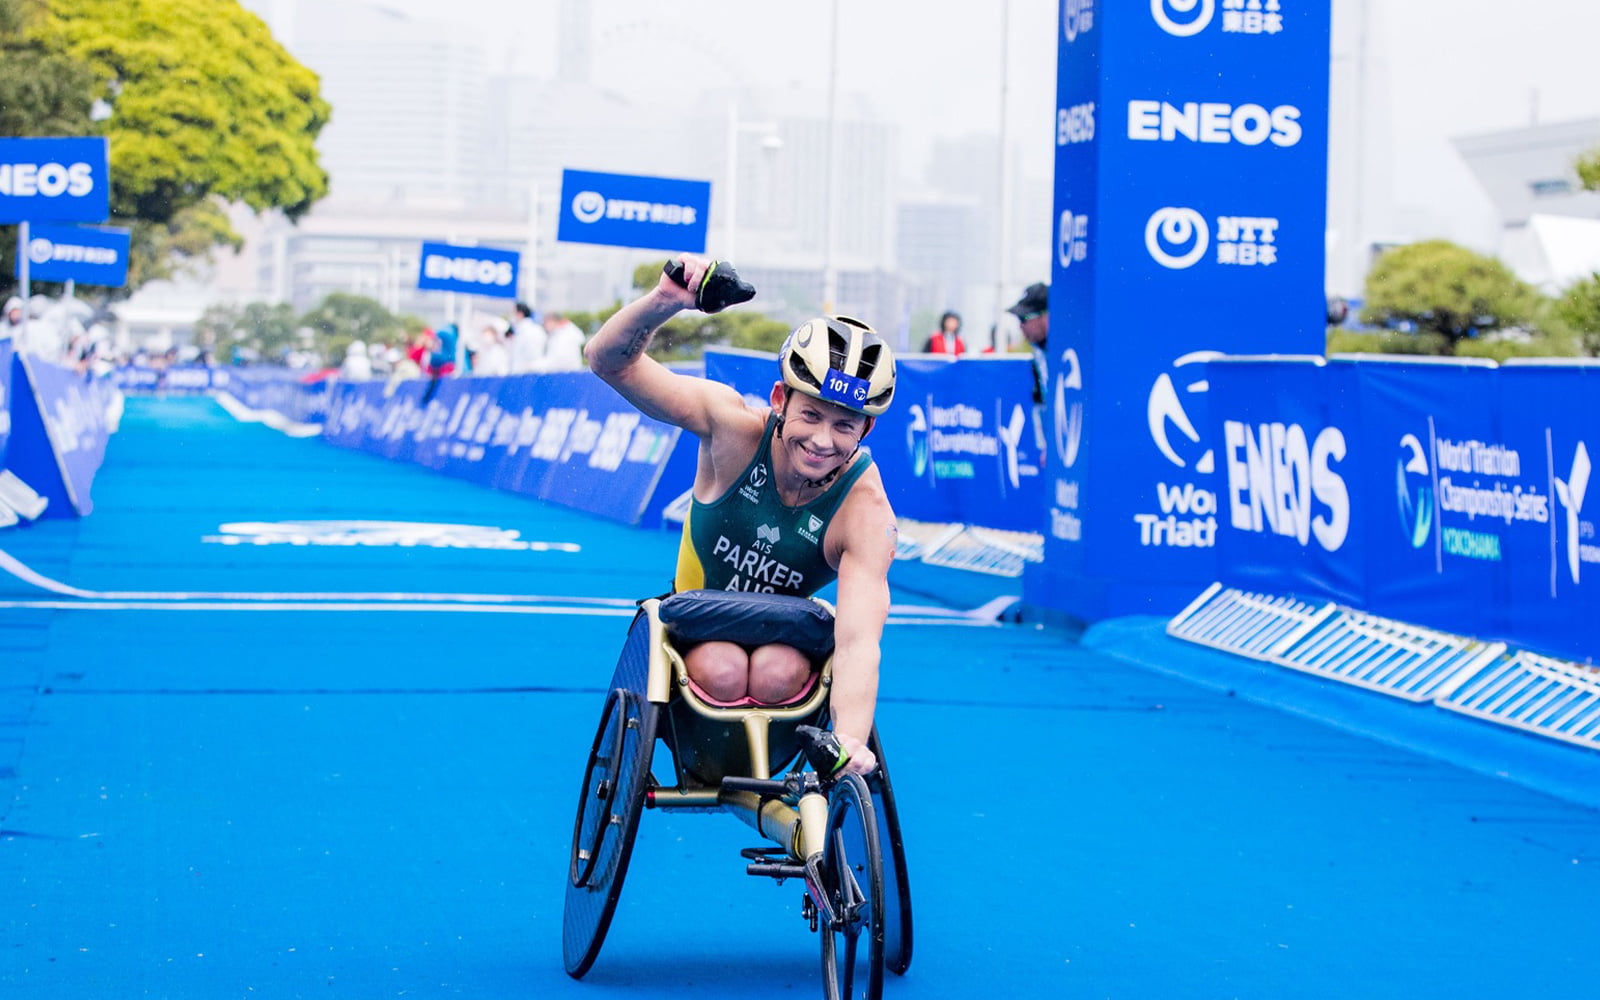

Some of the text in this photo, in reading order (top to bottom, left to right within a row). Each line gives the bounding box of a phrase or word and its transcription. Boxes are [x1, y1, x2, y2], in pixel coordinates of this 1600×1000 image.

[1128, 99, 1302, 147] ENEOS
[1217, 215, 1279, 242] NTT
[424, 254, 513, 287] ENEOS
[829, 378, 849, 394] 101
[1224, 419, 1350, 552] ENEOS
[712, 534, 804, 590] PARKER
[751, 539, 774, 554] AIS
